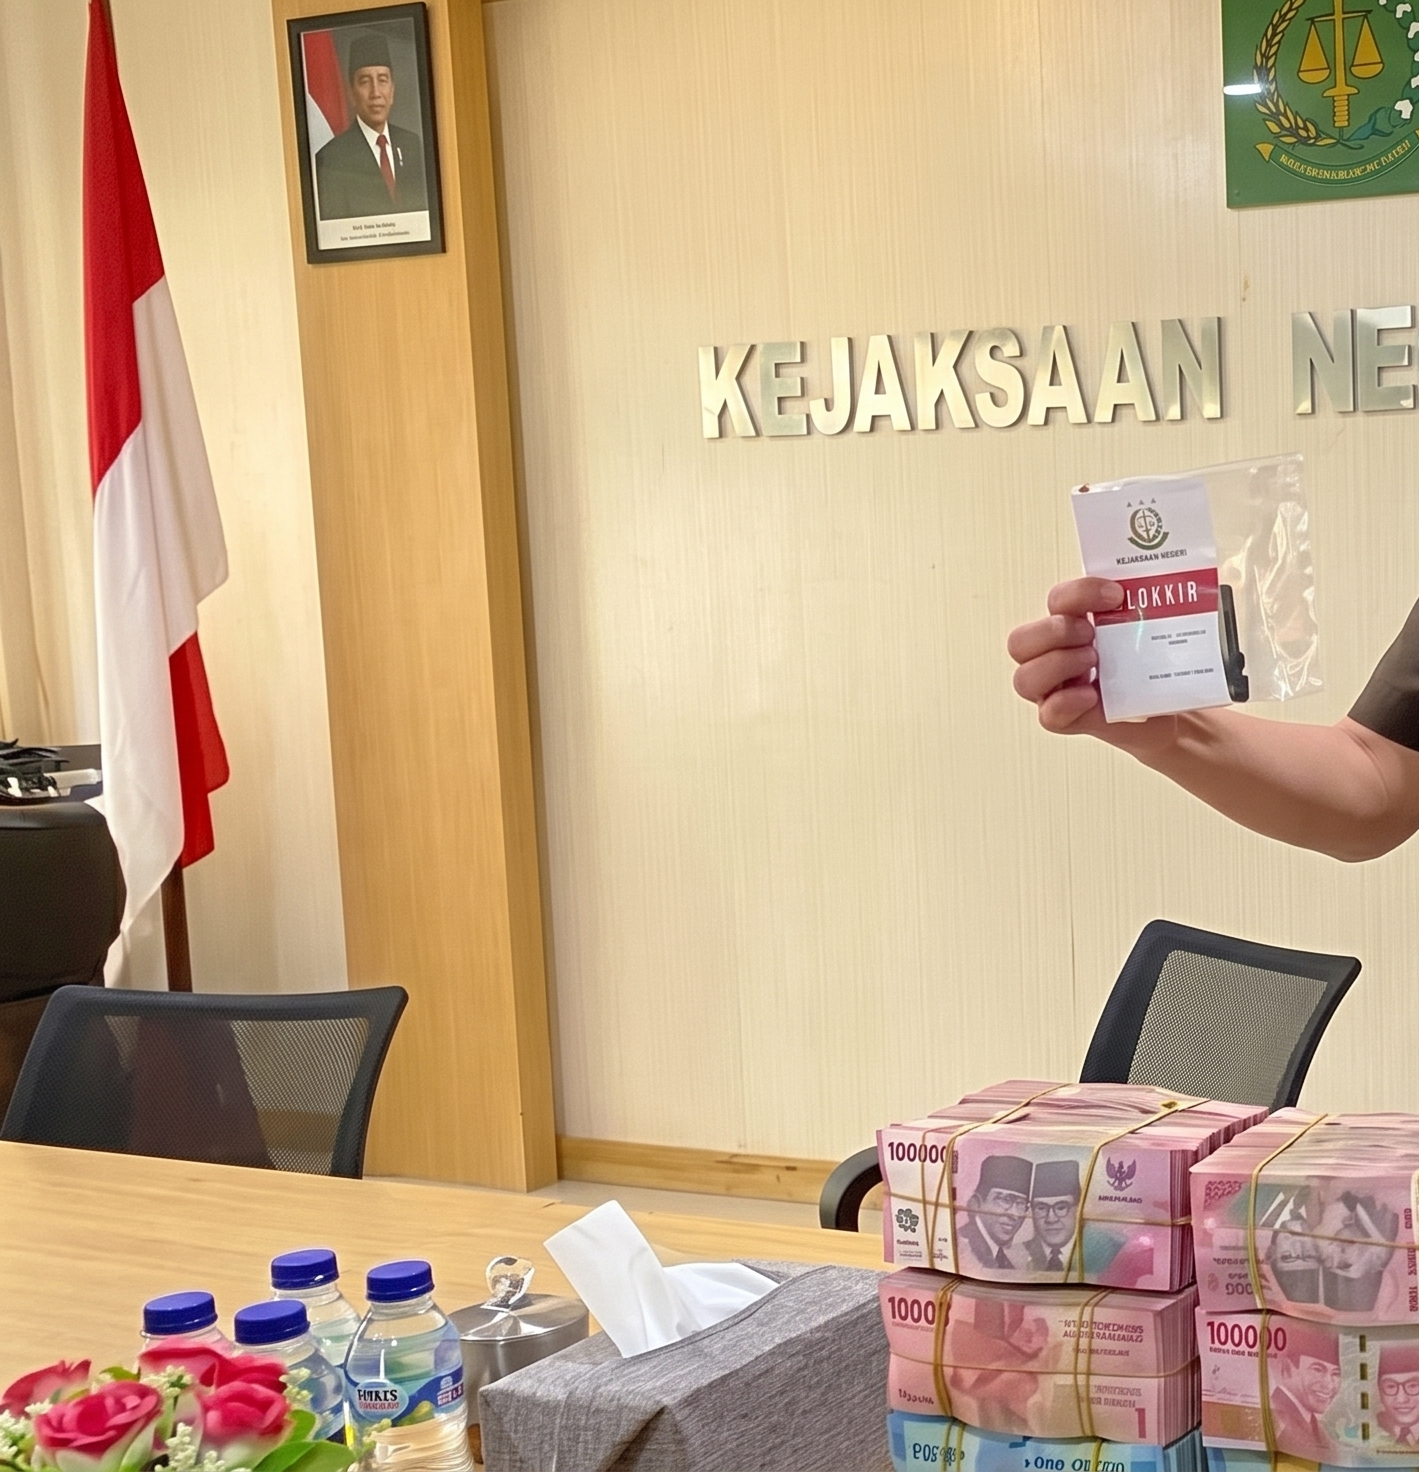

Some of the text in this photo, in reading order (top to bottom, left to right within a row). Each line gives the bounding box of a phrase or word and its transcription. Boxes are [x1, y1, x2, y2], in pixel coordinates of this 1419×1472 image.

[698, 316, 1222, 440] KEJAKSAAN
[1116, 549, 1187, 565] KEJAKSAAN NEGERI
[1115, 581, 1198, 611] LOKKIR
